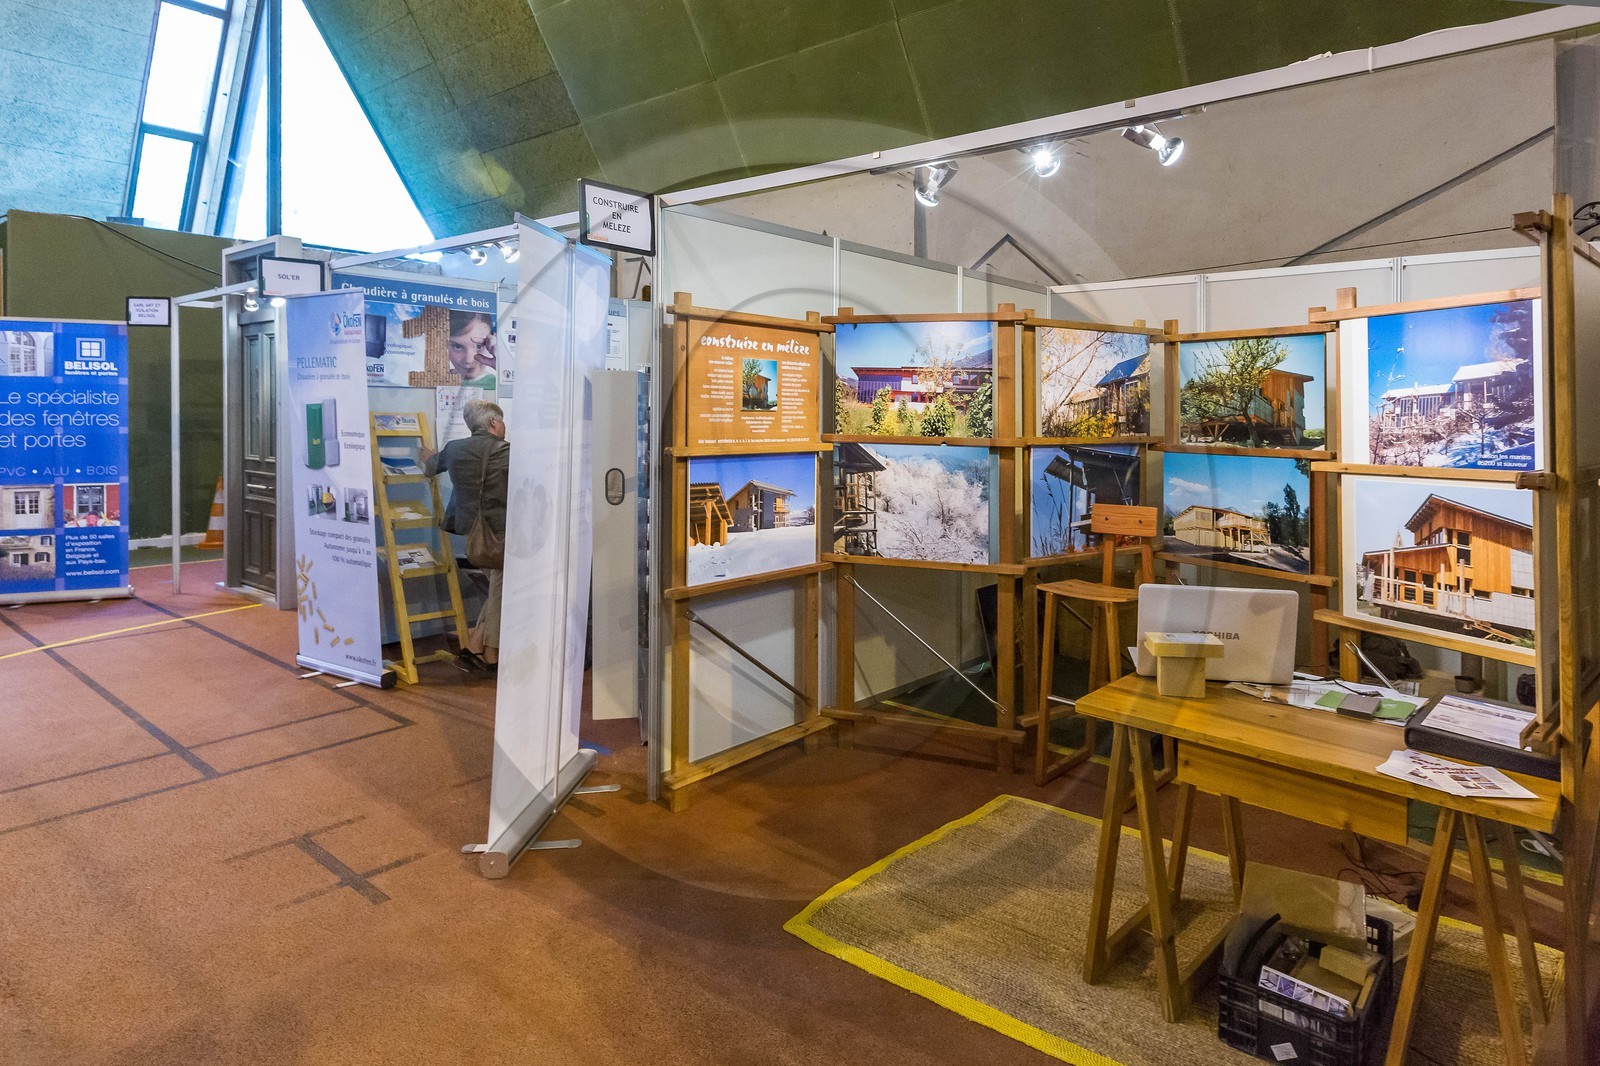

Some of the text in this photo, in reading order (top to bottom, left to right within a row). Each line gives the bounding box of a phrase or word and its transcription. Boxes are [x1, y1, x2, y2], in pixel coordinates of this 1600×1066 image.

[592, 196, 639, 214] CONSTRUIRE
[612, 211, 622, 220] EN
[602, 221, 631, 233] MELEZE
[277, 273, 300, 281] SOL'ER
[341, 282, 490, 309] Cudière à granulés de bois
[701, 334, 810, 355] construire en mélèze
[64, 361, 118, 371] BELISOL
[296, 356, 337, 369] PELLEMATIC
[27, 389, 119, 407] spécialiste
[0, 410, 119, 427] des fenêtres
[0, 432, 87, 451] et portes
[0, 465, 118, 477] PVC ALU BOIS
[1192, 631, 1240, 640] HIBA
